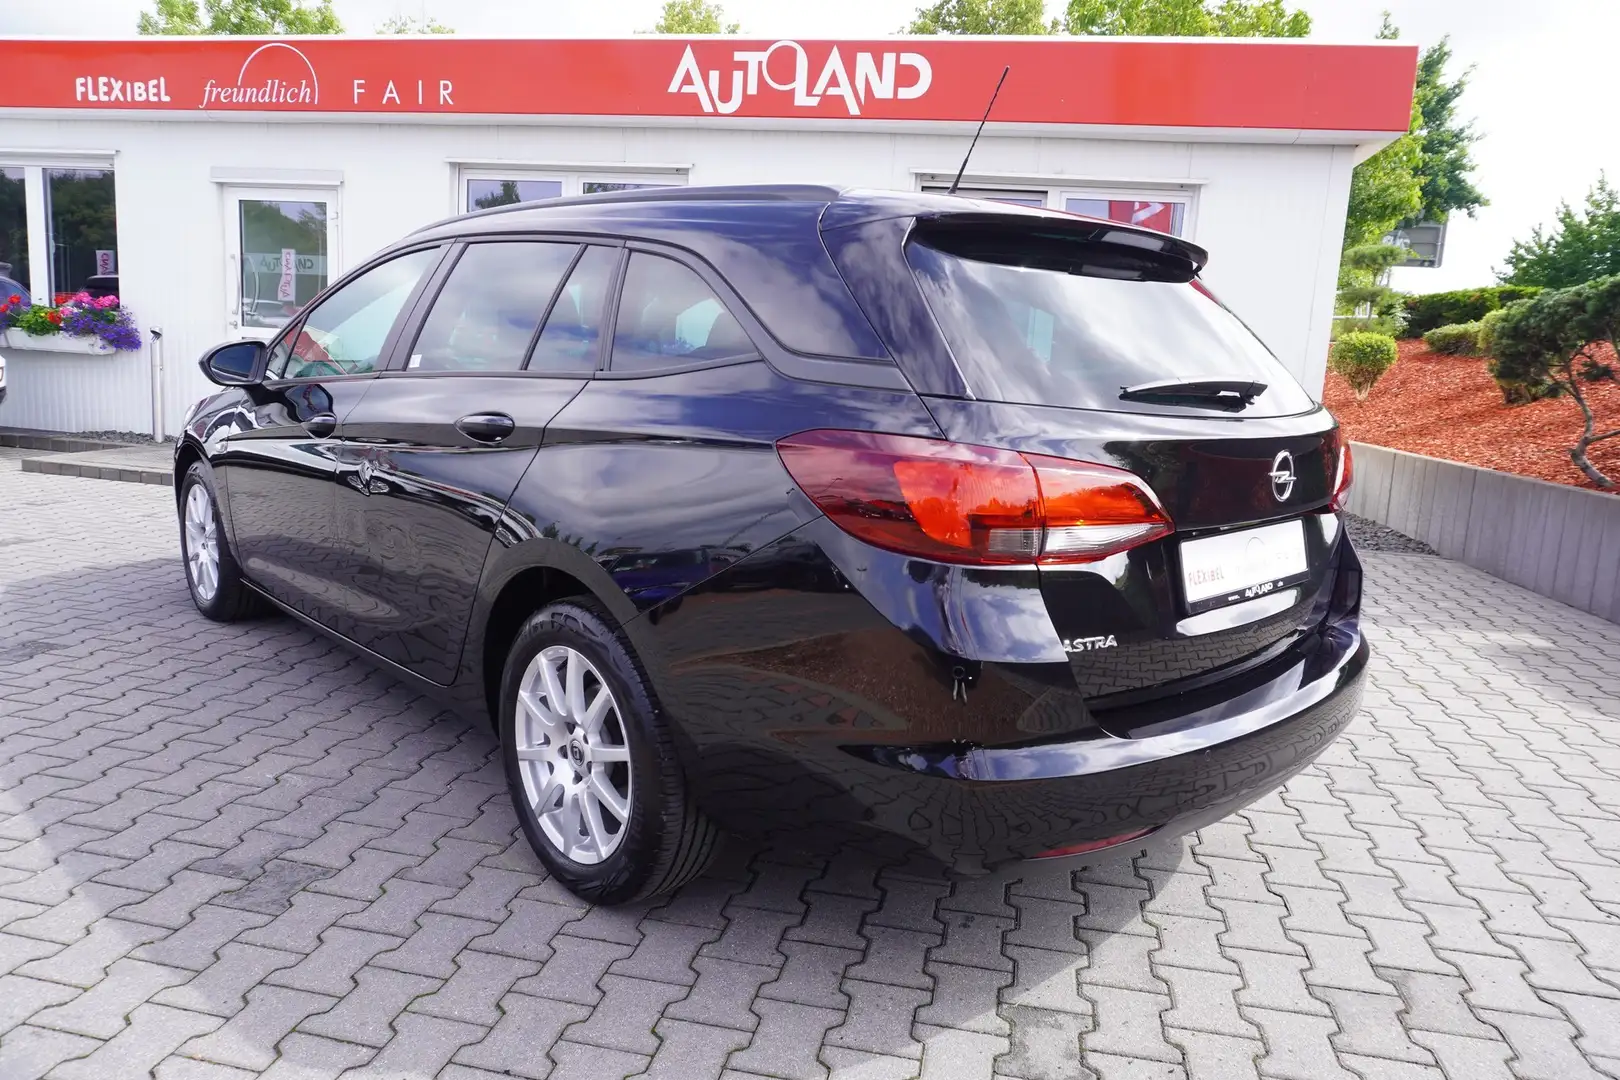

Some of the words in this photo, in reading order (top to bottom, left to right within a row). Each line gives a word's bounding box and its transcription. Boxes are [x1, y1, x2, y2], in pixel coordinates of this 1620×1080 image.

[75, 76, 171, 102] FLEXIBEL
[668, 40, 933, 116] AUTOLAND
[199, 79, 312, 108] freundlich
[353, 79, 454, 105] FAIR
[1063, 634, 1118, 653] ASTRA
